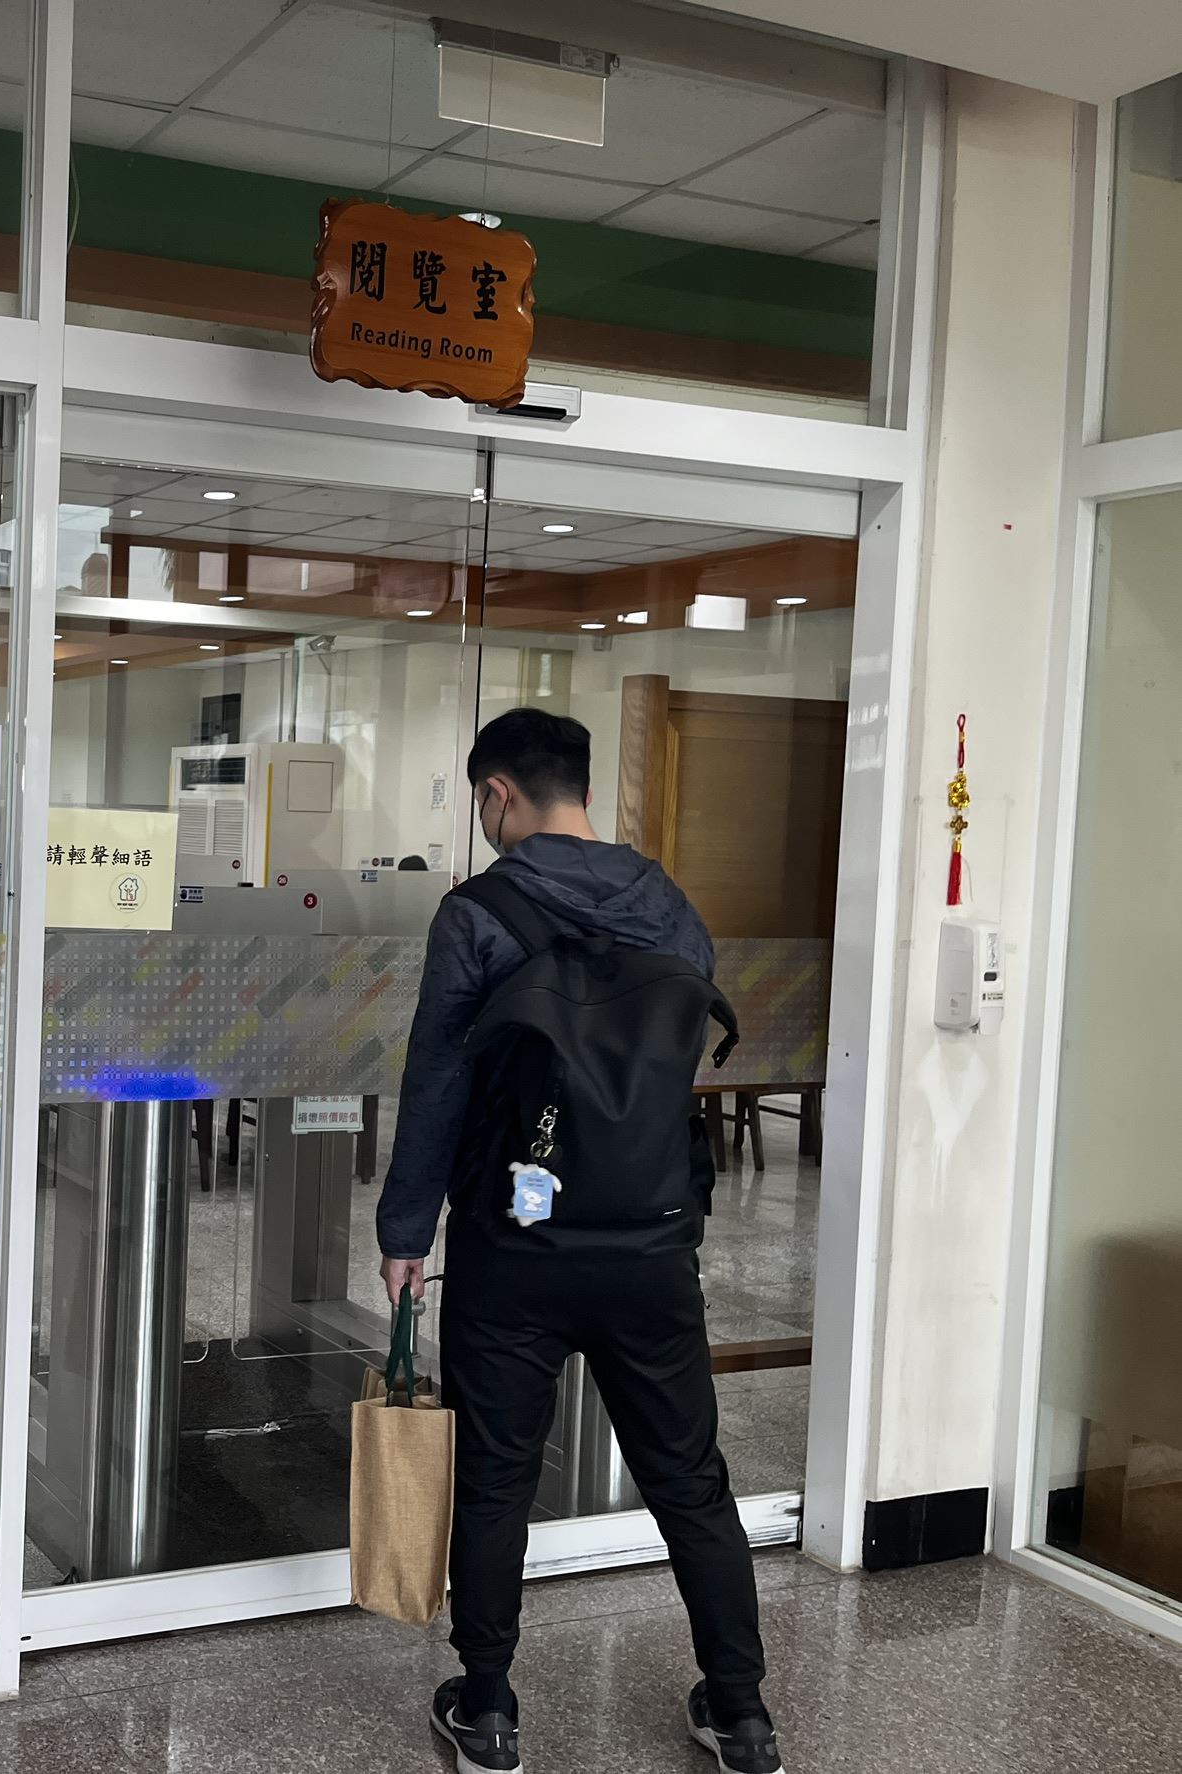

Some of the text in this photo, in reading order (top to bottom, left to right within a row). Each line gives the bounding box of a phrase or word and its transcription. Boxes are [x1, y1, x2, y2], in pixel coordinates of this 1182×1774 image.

[350, 240, 507, 321] 閱覽室
[351, 322, 493, 364] Reading Room
[46, 844, 153, 868] 請輕聲細語
[307, 896, 314, 905] 3
